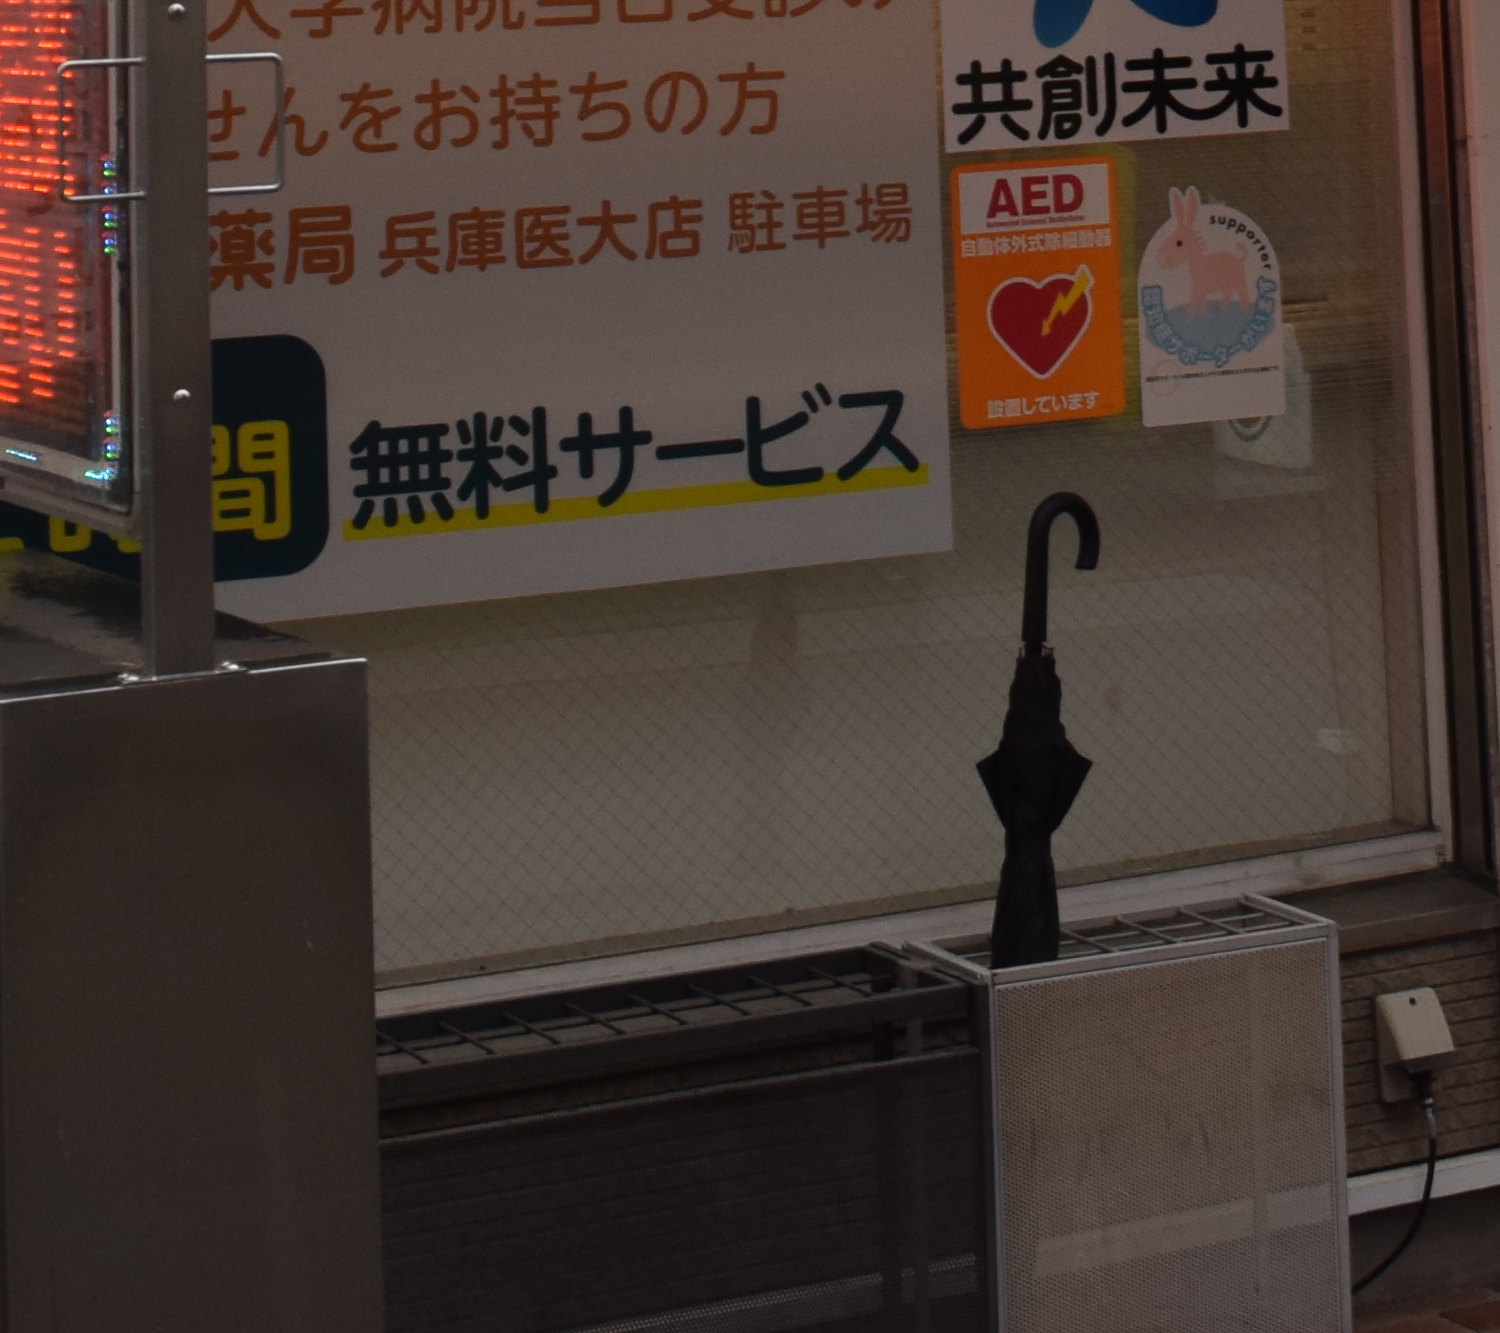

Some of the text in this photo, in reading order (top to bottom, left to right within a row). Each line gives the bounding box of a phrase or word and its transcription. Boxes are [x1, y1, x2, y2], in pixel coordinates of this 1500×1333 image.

[950, 43, 1285, 146] 共創未来
[986, 173, 1085, 219] AED
[209, 182, 913, 291] 薬局 兵庫医大店 駐車場
[960, 228, 1112, 259] 自動体外式除細動器
[1208, 214, 1273, 271] supporter
[986, 390, 1100, 420] 設置しています
[350, 381, 920, 530] 無料サービス
